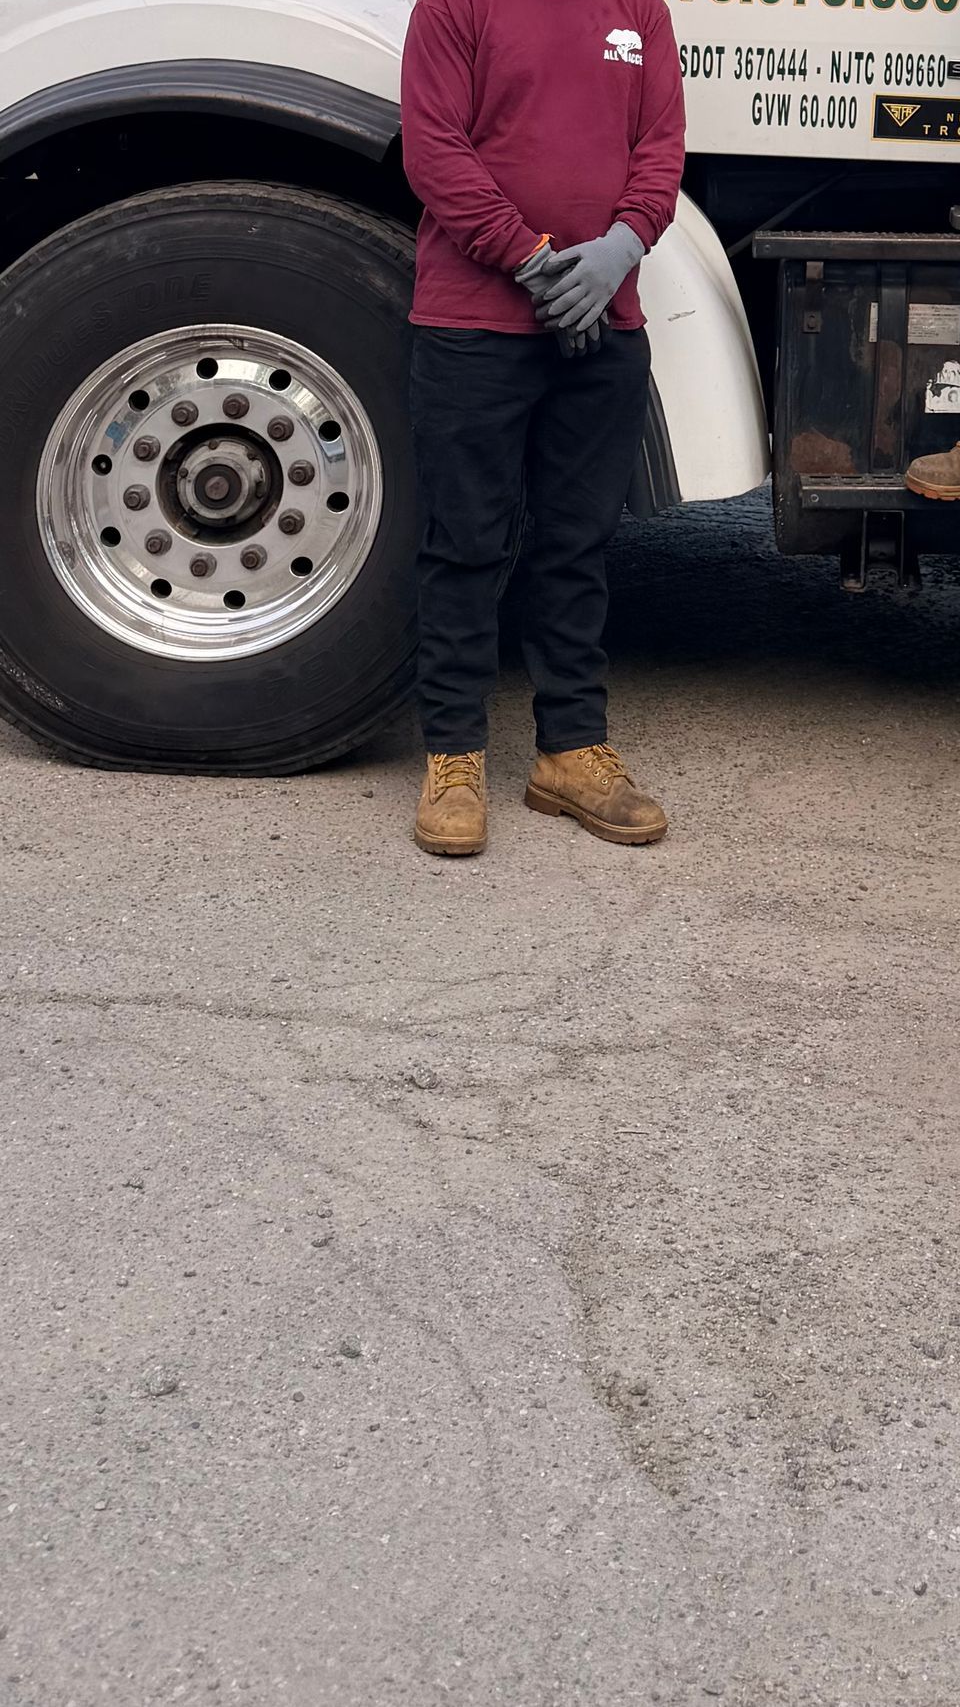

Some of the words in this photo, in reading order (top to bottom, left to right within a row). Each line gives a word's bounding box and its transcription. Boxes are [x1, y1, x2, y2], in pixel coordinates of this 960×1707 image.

[603, 49, 620, 61] ALL
[734, 46, 808, 82] 3670444
[830, 50, 876, 85] NJTC
[884, 52, 946, 88] 809660
[751, 92, 792, 127] GVW
[799, 94, 858, 129] 60.000
